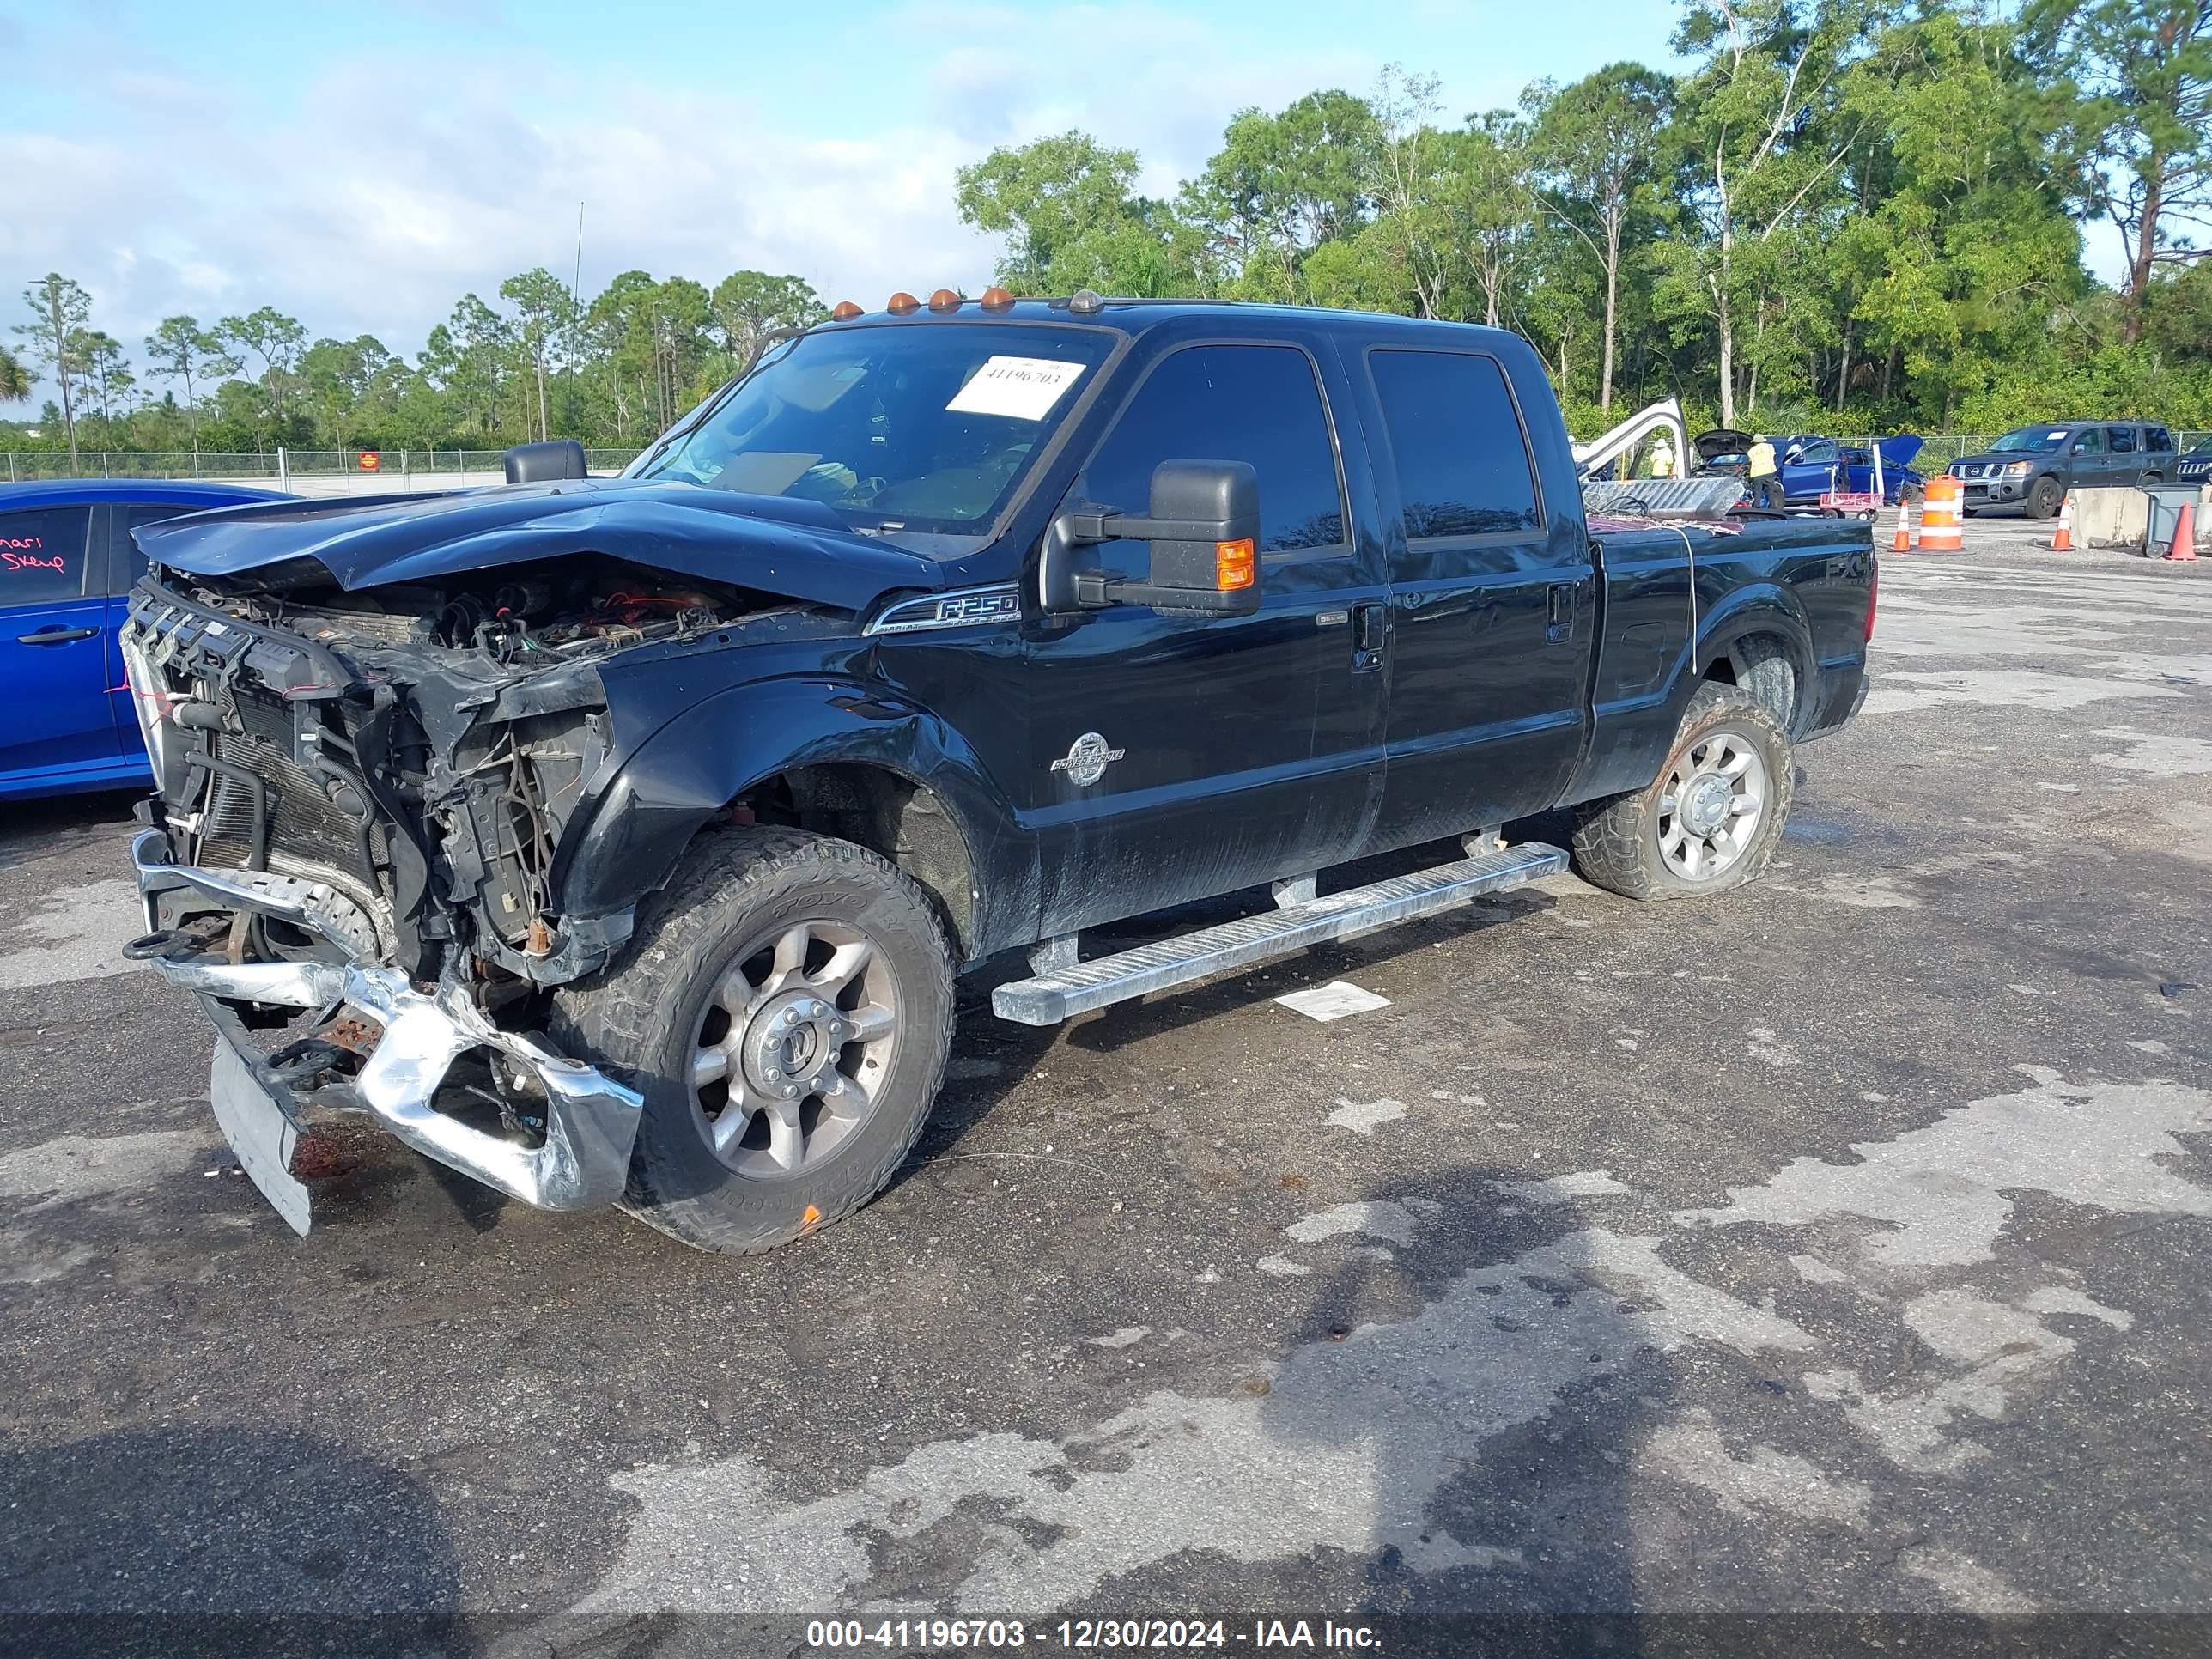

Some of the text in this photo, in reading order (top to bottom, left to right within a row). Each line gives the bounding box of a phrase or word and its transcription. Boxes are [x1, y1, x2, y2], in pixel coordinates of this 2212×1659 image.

[988, 368, 1062, 385] 41196703
[1051, 756, 1089, 771] POWER
[1089, 749, 1125, 766] STROKE
[773, 891, 867, 919] TOYO
